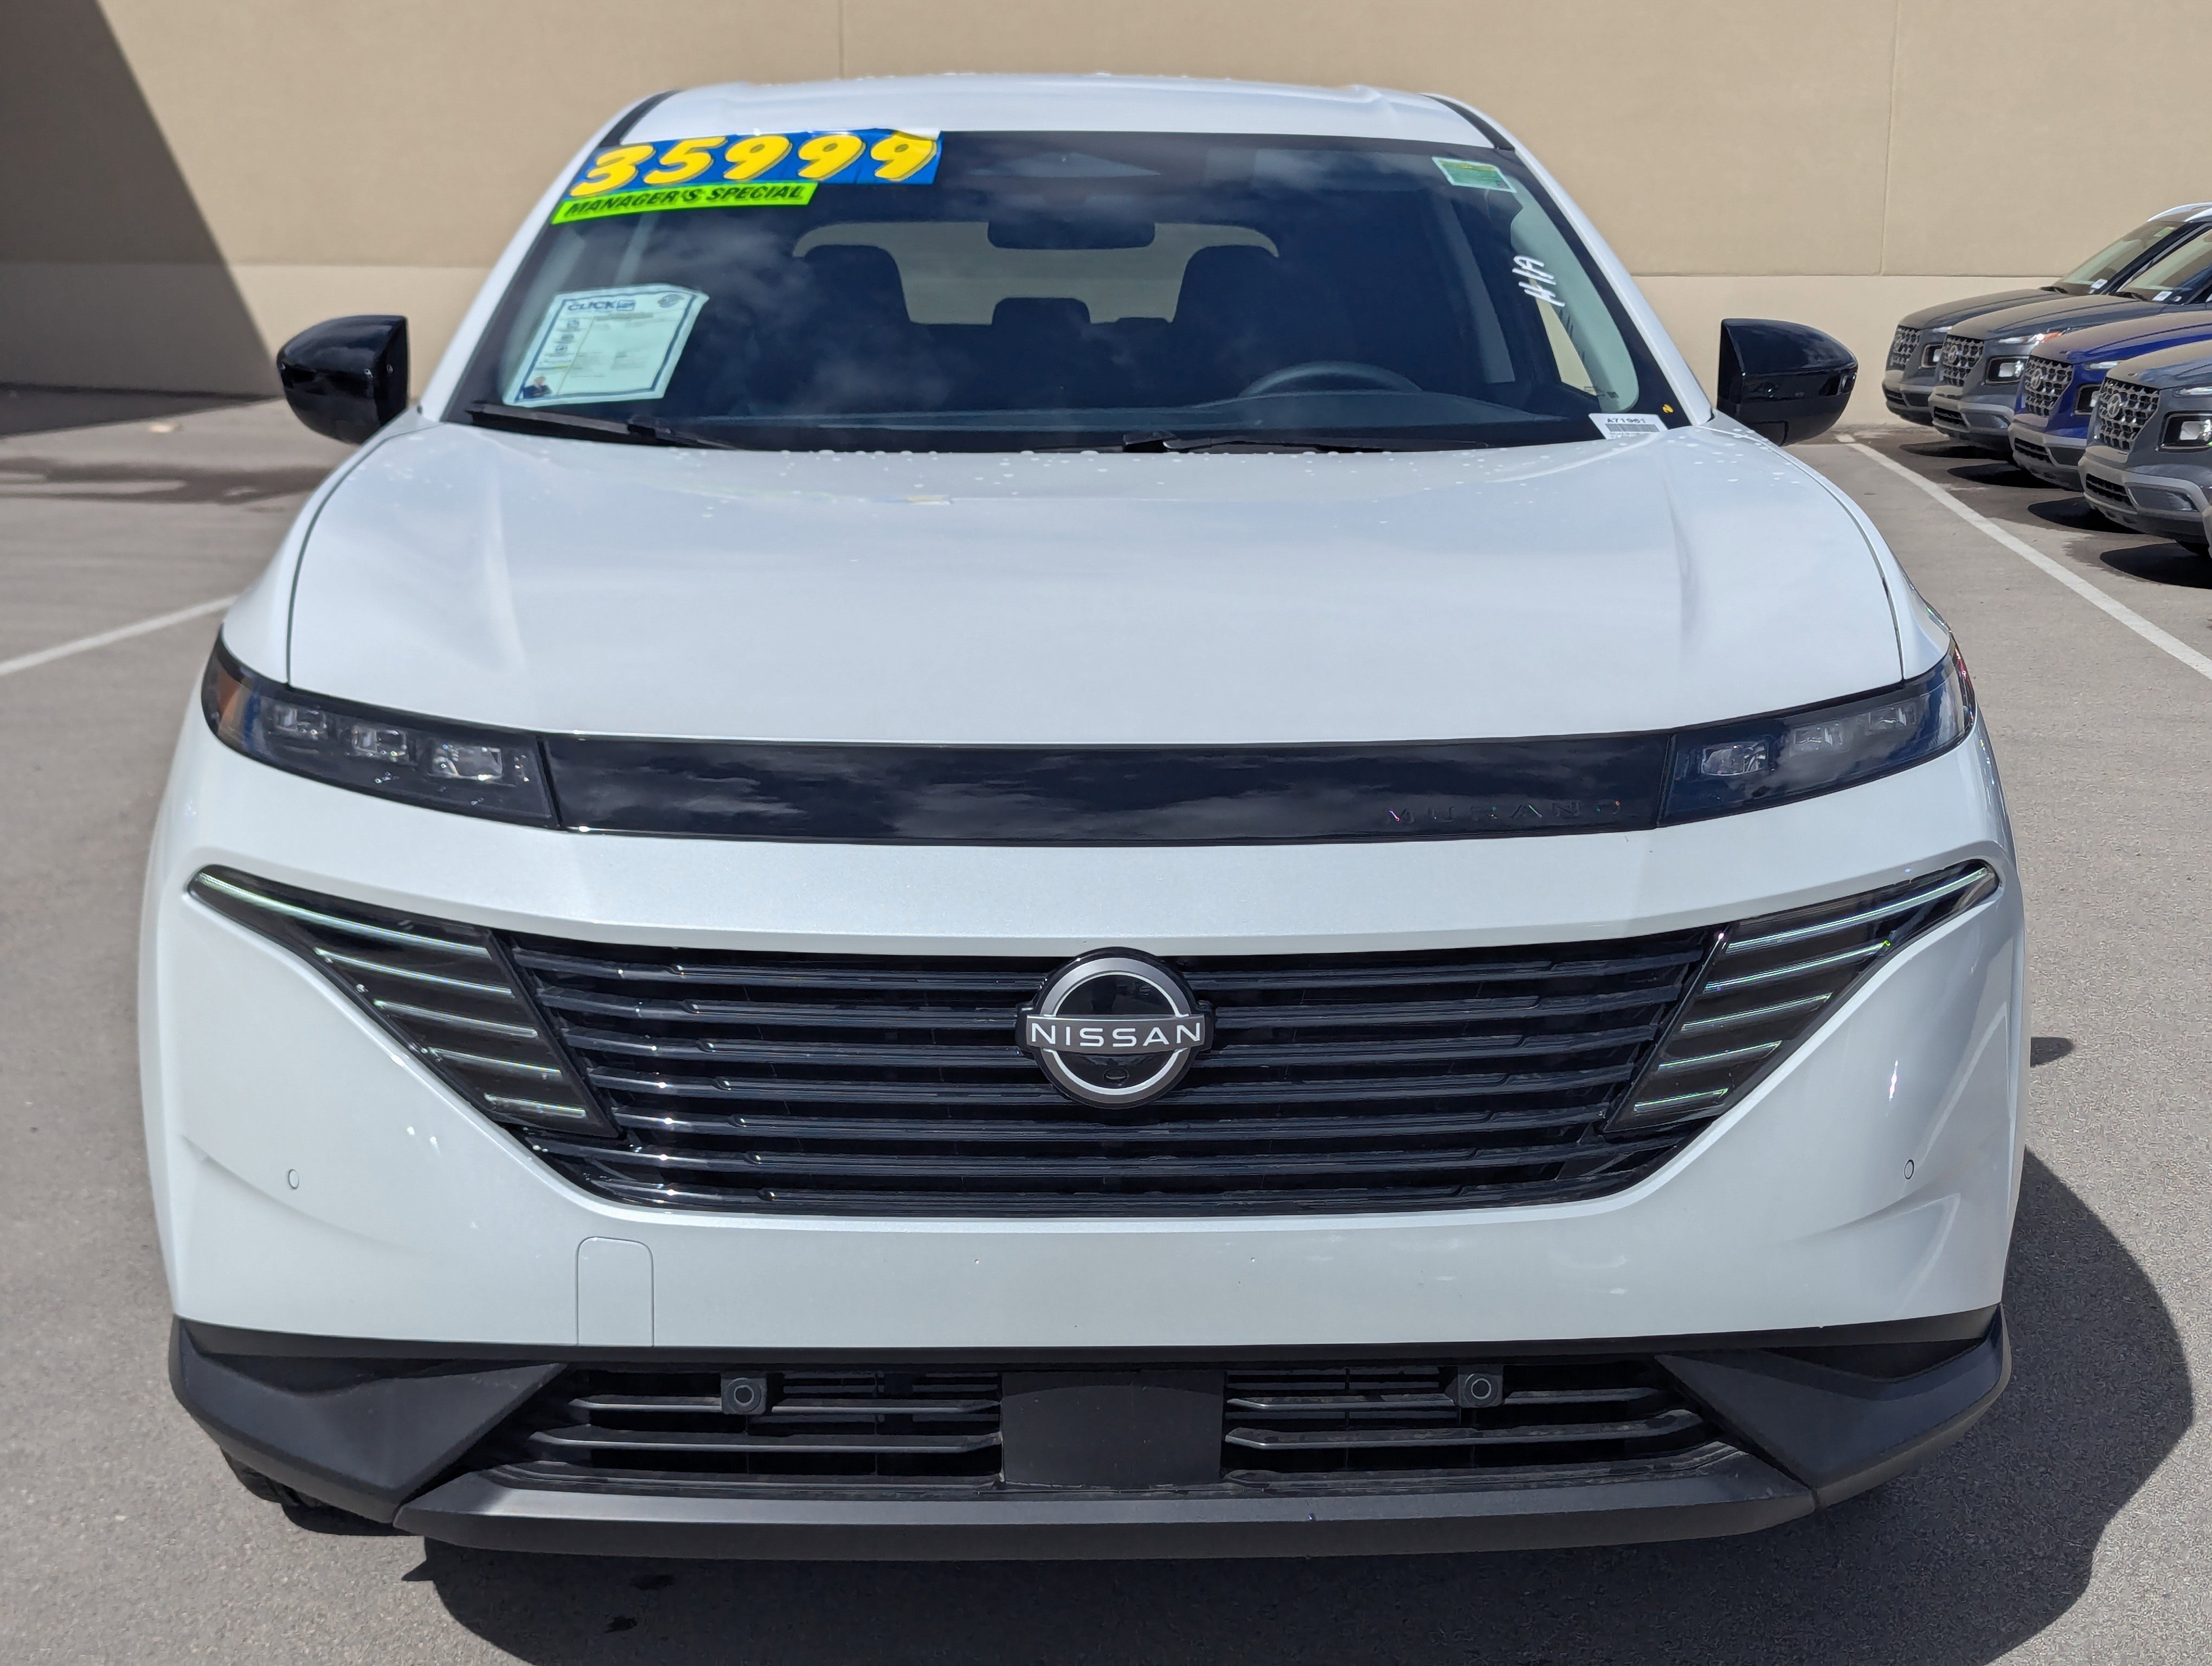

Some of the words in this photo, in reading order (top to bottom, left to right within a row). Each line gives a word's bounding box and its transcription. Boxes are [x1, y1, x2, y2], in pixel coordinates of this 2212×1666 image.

[570, 134, 936, 197] 35999
[564, 188, 700, 217] MANAGER'S
[707, 185, 803, 201] SPECIAL
[1031, 1022, 1200, 1047] NISSAN
